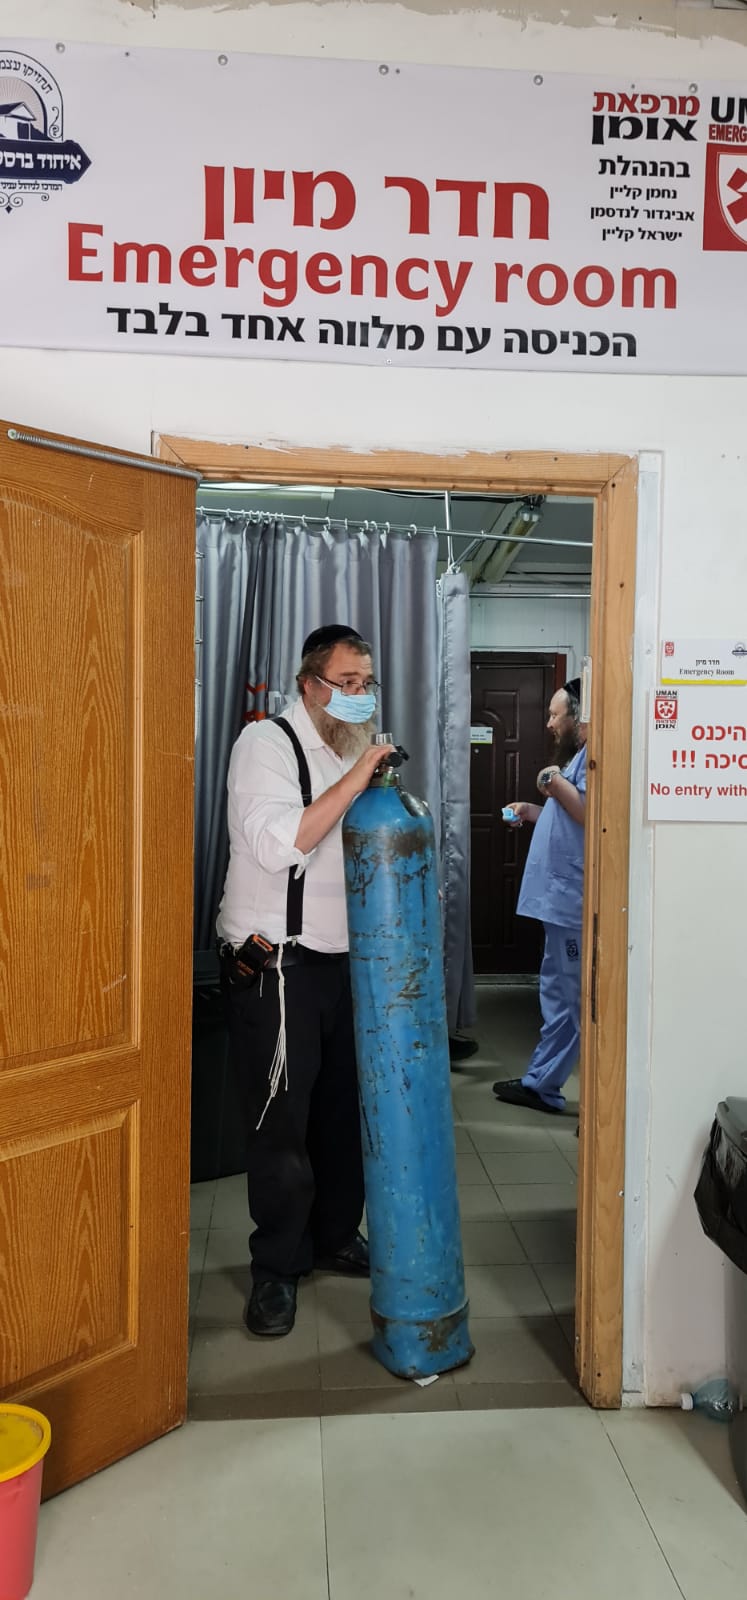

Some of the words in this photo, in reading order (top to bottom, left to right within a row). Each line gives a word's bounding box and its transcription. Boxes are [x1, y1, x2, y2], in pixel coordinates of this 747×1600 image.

[23, 64, 53, 94] תחזיקו
[592, 92, 700, 116] מרפאת
[592, 115, 698, 145] אומן
[37, 153, 81, 170] איחוד
[598, 155, 690, 178] בהנהלת
[204, 165, 356, 240] מיון
[610, 185, 642, 200] קליין
[646, 187, 677, 200] נחמן
[385, 175, 550, 240] חדר
[590, 206, 639, 219] לנדסמן
[643, 208, 695, 222] אביגדור
[602, 226, 634, 242] קליין
[638, 227, 682, 241] ישראל
[68, 222, 473, 317] Emergency
[495, 262, 677, 309] room
[107, 302, 209, 337] בלבד
[221, 313, 305, 342] אחד
[318, 315, 424, 350] מלווה
[437, 325, 491, 354] עם
[503, 327, 637, 357] הכניסה
[680, 668, 714, 677] Emergency
[650, 783, 670, 796] No
[675, 785, 712, 799] entry
